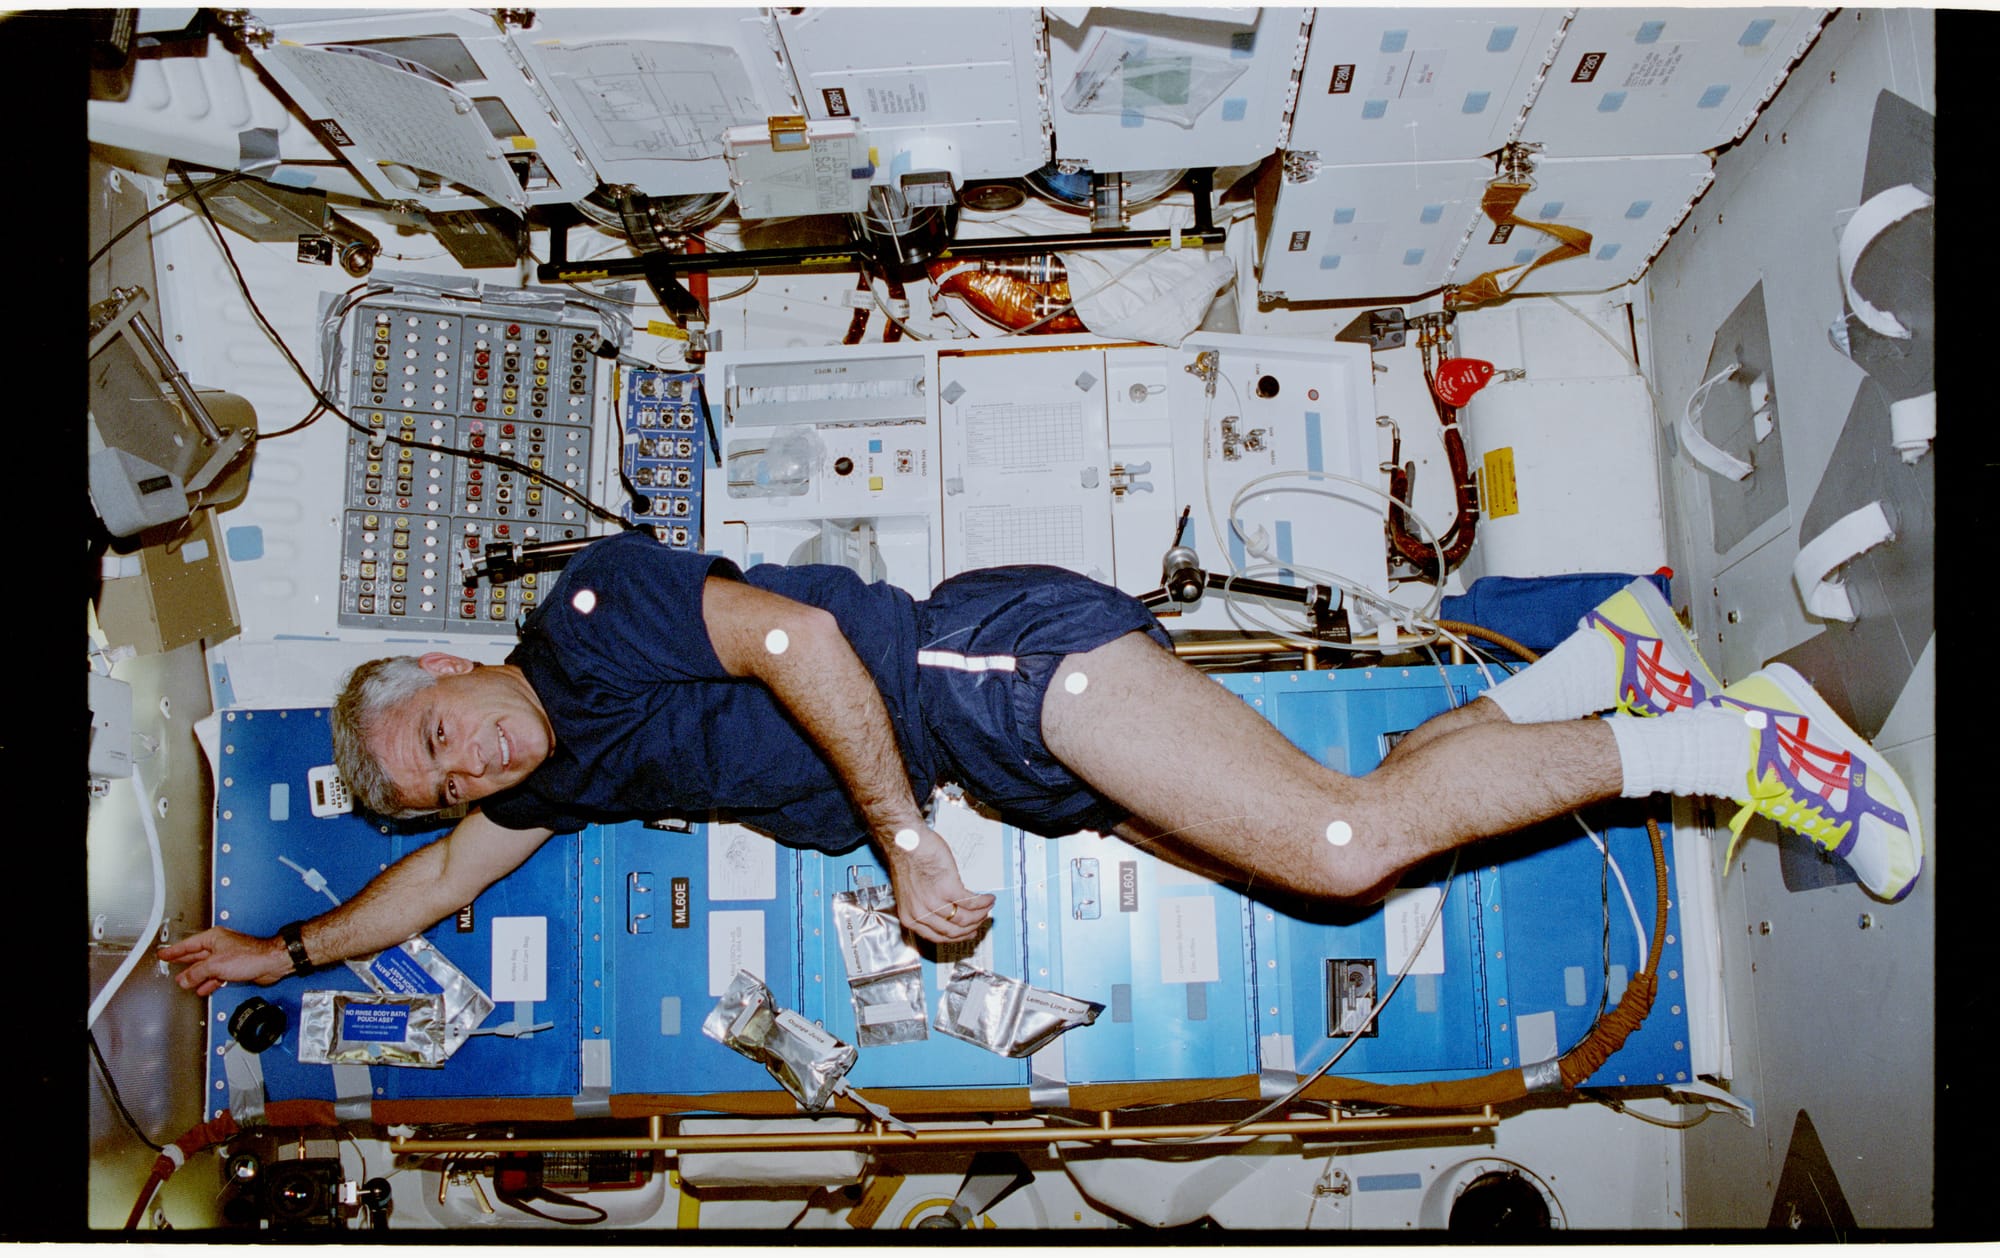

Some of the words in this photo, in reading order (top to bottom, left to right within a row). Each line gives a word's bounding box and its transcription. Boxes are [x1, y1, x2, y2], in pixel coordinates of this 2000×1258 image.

[815, 156, 832, 173] OPS
[832, 157, 850, 207] CHECKLIST
[1123, 867, 1135, 906] ML60J
[674, 883, 686, 924] ML60E
[387, 973, 406, 992] BODY
[388, 965, 405, 982] ASSY
